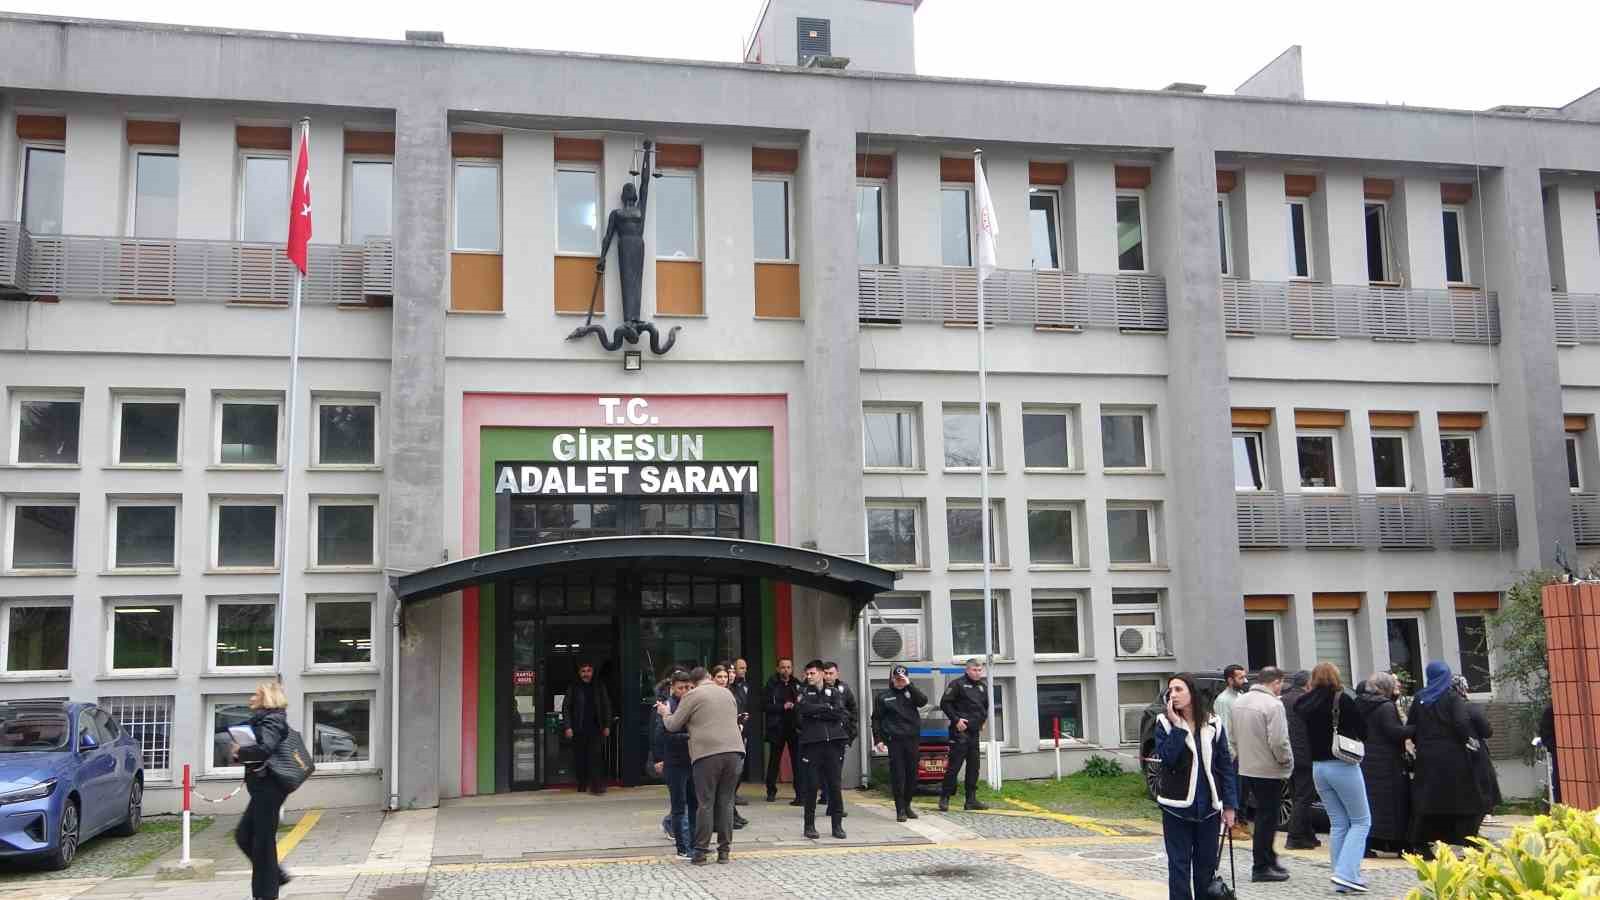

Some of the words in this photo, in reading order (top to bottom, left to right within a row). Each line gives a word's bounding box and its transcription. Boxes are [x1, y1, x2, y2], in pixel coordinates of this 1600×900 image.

[598, 398, 659, 425] T.C.
[552, 429, 704, 461] GİRESUN
[495, 466, 629, 494] ADALET
[640, 466, 758, 493] SARAYI
